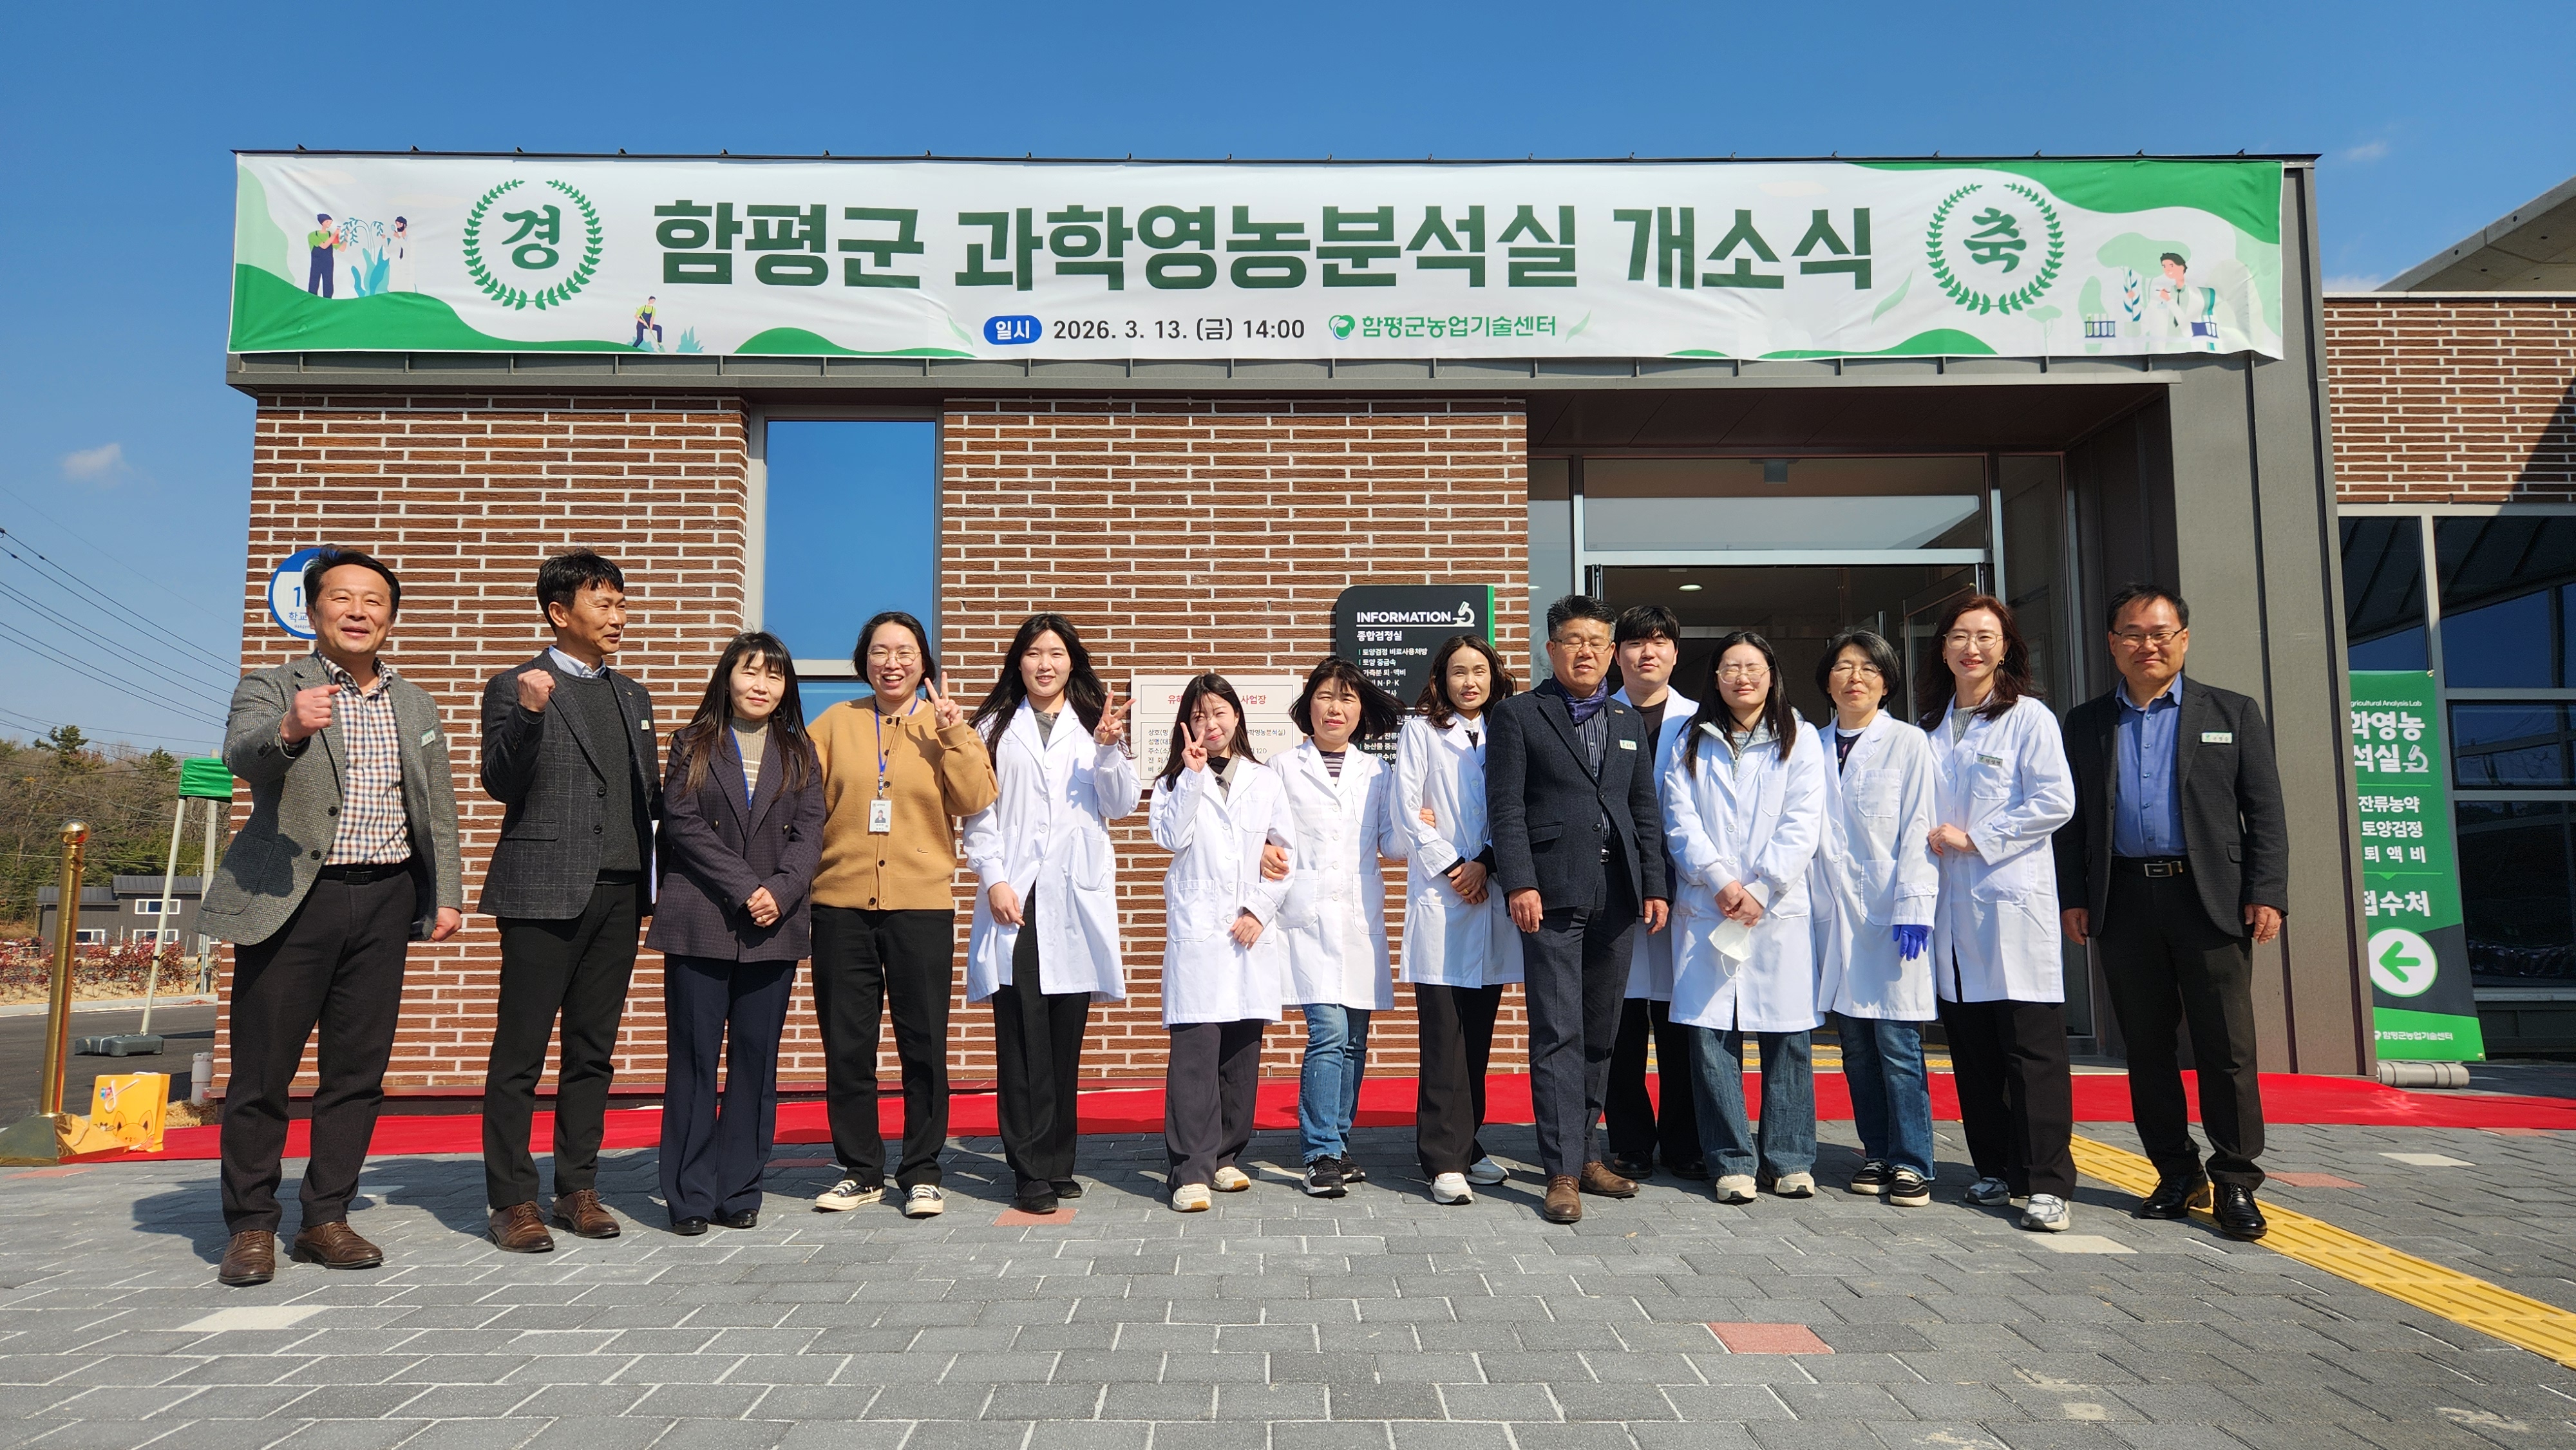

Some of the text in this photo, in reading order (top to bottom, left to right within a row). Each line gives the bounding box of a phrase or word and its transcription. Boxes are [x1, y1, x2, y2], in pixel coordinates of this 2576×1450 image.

[502, 203, 559, 270] 경
[654, 200, 1871, 291] 함평군 과학영농분석실 개소식
[1963, 207, 2027, 273] 축
[995, 317, 1305, 341] 일시 2026. 3. 13. (금) 14:00
[1362, 315, 1556, 338] 함평군농업기술센터
[1357, 611, 1451, 623] INFORMATION
[1356, 630, 1403, 641] 종합검정실
[1240, 695, 1267, 704] 사업장
[2358, 796, 2420, 813] 잔류농약
[2362, 820, 2423, 838] 토양검정
[2383, 1031, 2453, 1040] 함평군농업기술센터
